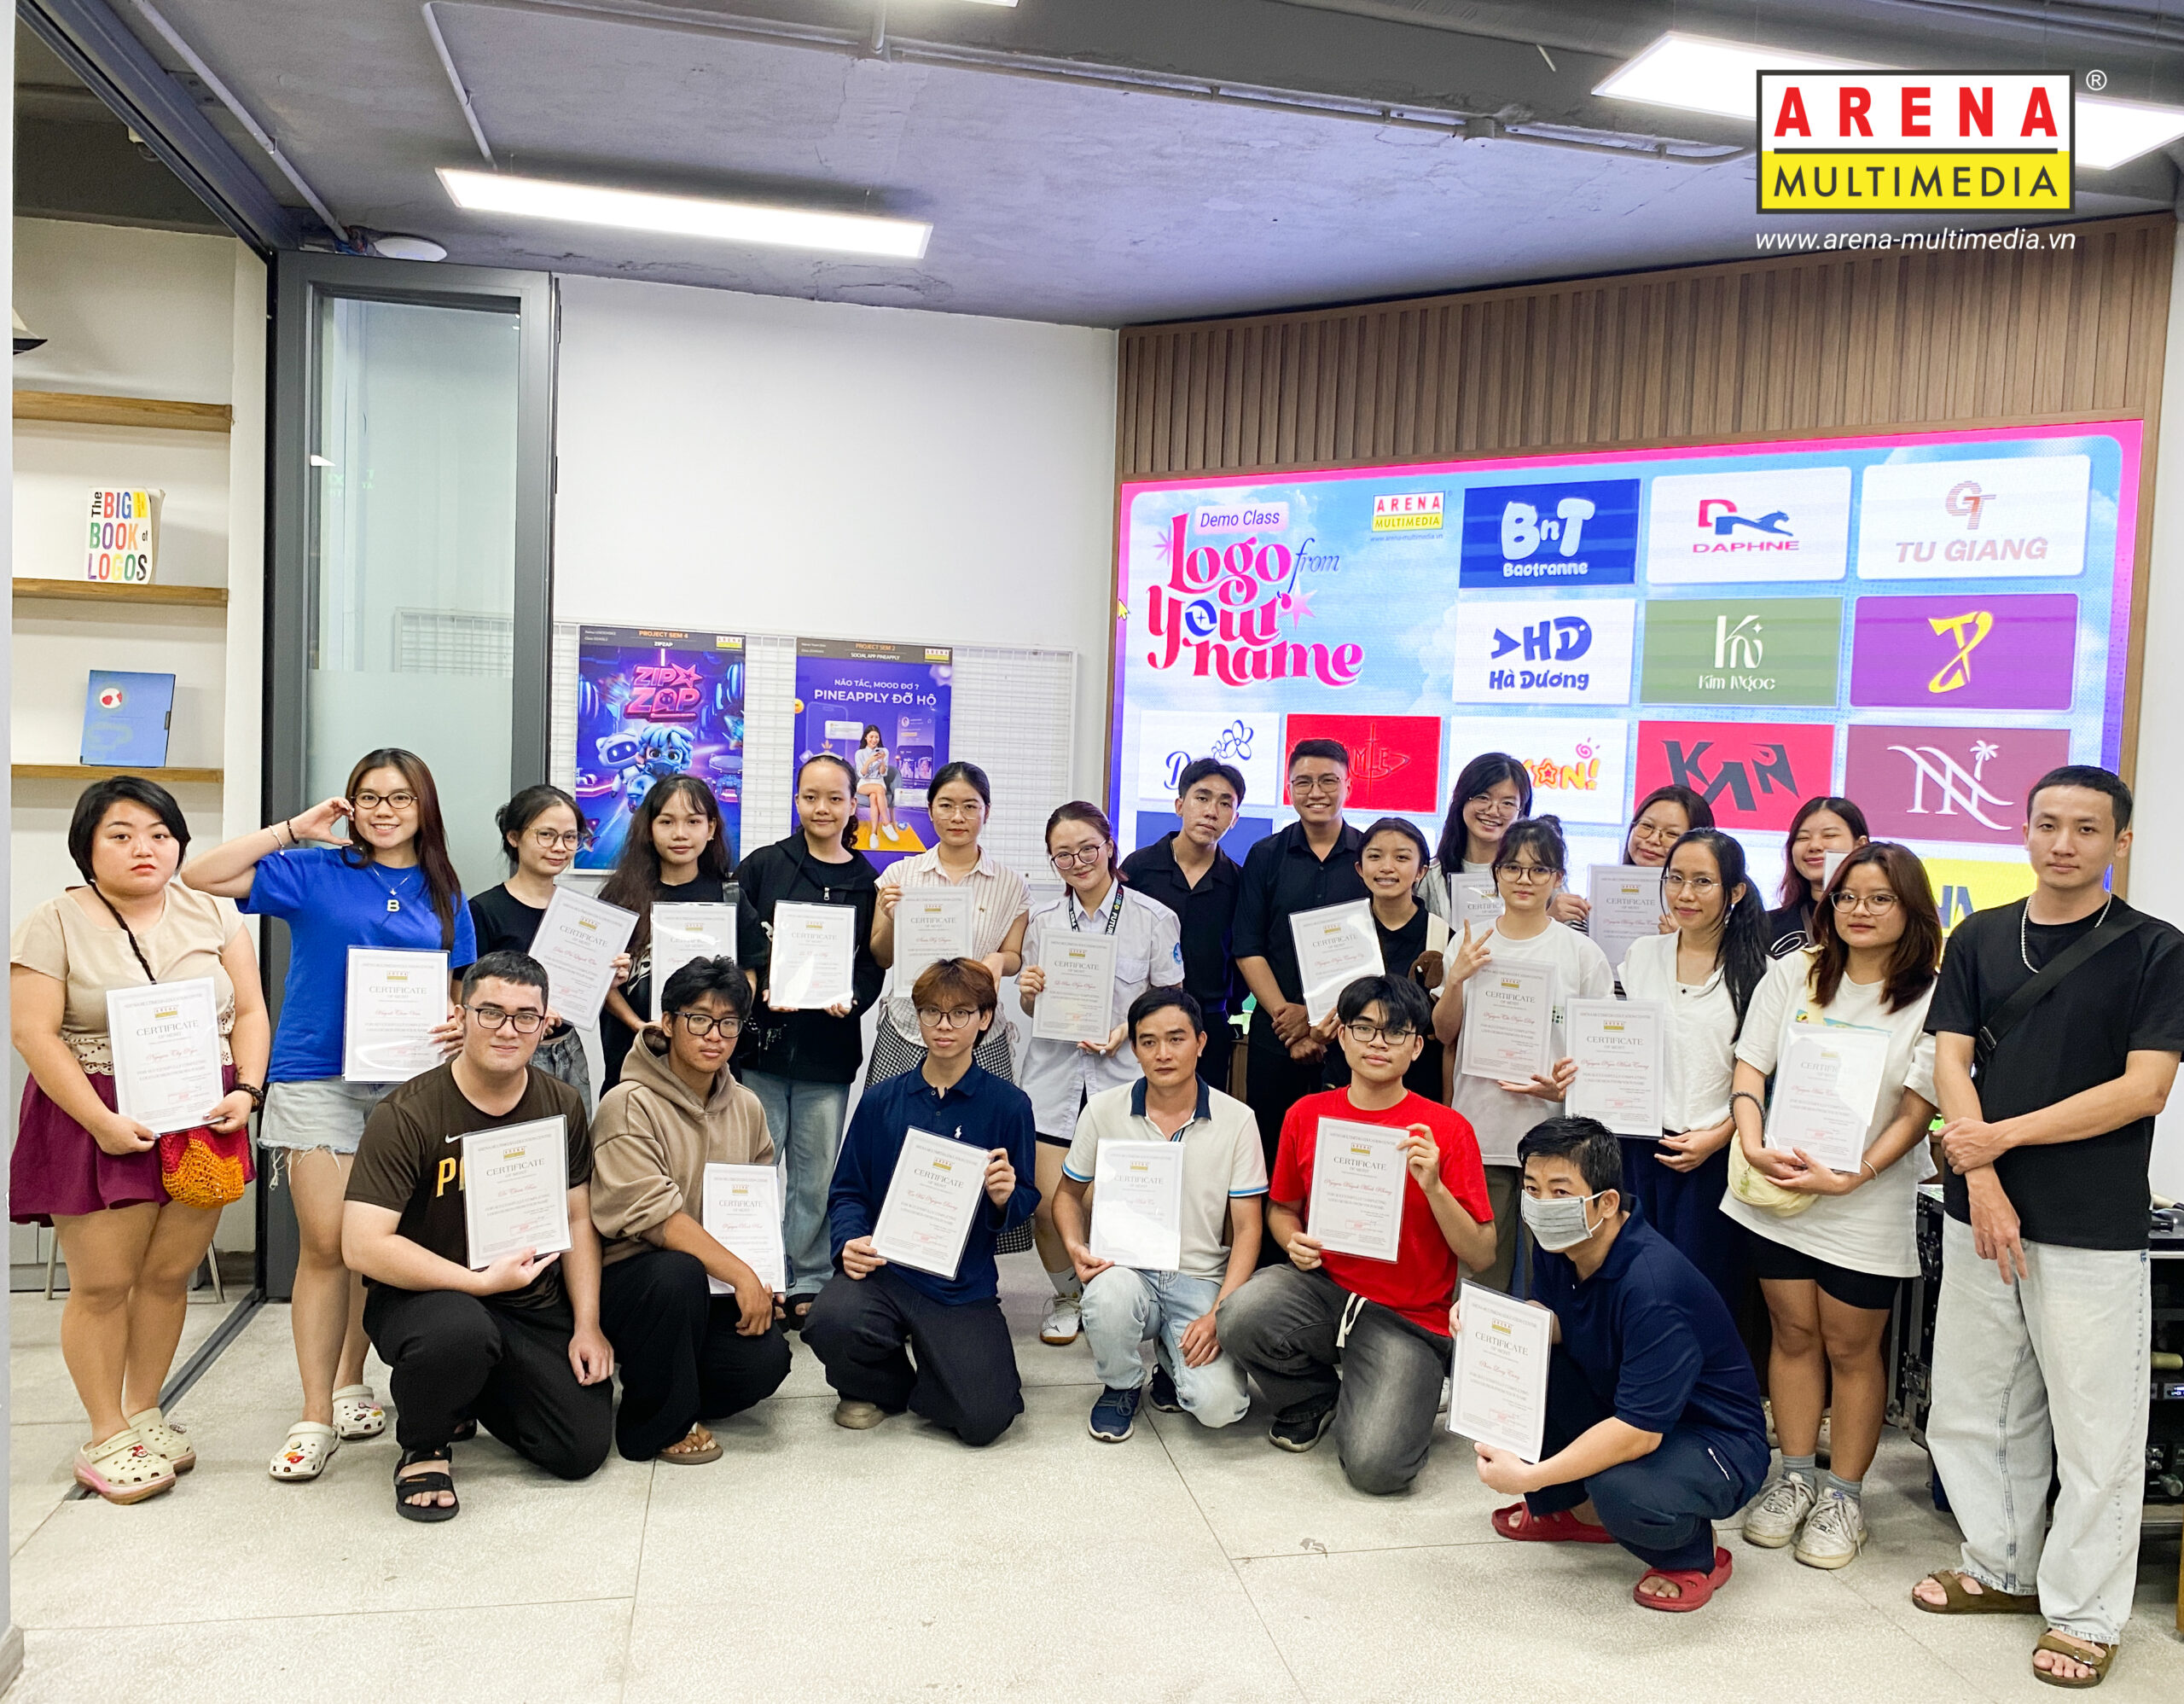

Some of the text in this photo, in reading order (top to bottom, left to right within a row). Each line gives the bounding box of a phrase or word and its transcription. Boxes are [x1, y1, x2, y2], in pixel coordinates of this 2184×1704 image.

[91, 491, 102, 518] The
[103, 491, 132, 519] BIG
[1377, 496, 1440, 512] ARENA
[1200, 509, 1280, 527] Demo Class
[1374, 516, 1440, 528] MULTIMEDIA
[89, 522, 148, 550] BOOK of
[1501, 497, 1595, 561] BnT
[1693, 540, 1799, 553] DAPHNE
[1896, 537, 2048, 563] TU GIANG
[88, 553, 148, 581] LOGOS
[1168, 513, 1339, 606] Logo from
[1502, 562, 1589, 578] Baotranne
[1147, 584, 1292, 670] your
[1182, 637, 1364, 687] name
[633, 666, 677, 687] ZIP
[1489, 669, 1589, 691] Hà Dương
[1698, 675, 1725, 689] Kim
[625, 687, 701, 714] ZAP
[814, 689, 889, 704] PINEAPPLY
[892, 692, 914, 705] ĐỠ
[1606, 898, 1656, 906] CERTIFICATE
[560, 925, 608, 948] CERTIFICATE
[1054, 961, 1099, 970] CERTIFICATE
[369, 986, 427, 994] CERTIFICATE
[1485, 990, 1536, 1003] CERTIFICATE
[136, 1020, 199, 1037] CERTIFICATE
[1586, 1036, 1644, 1045] CERTIFICATE
[486, 1158, 545, 1177] CERTIFICATE
[1333, 1156, 1387, 1171] CERTIFICATE
[914, 1168, 964, 1189] CERTIFICATE
[1475, 1331, 1528, 1356] CERTIFICATE
